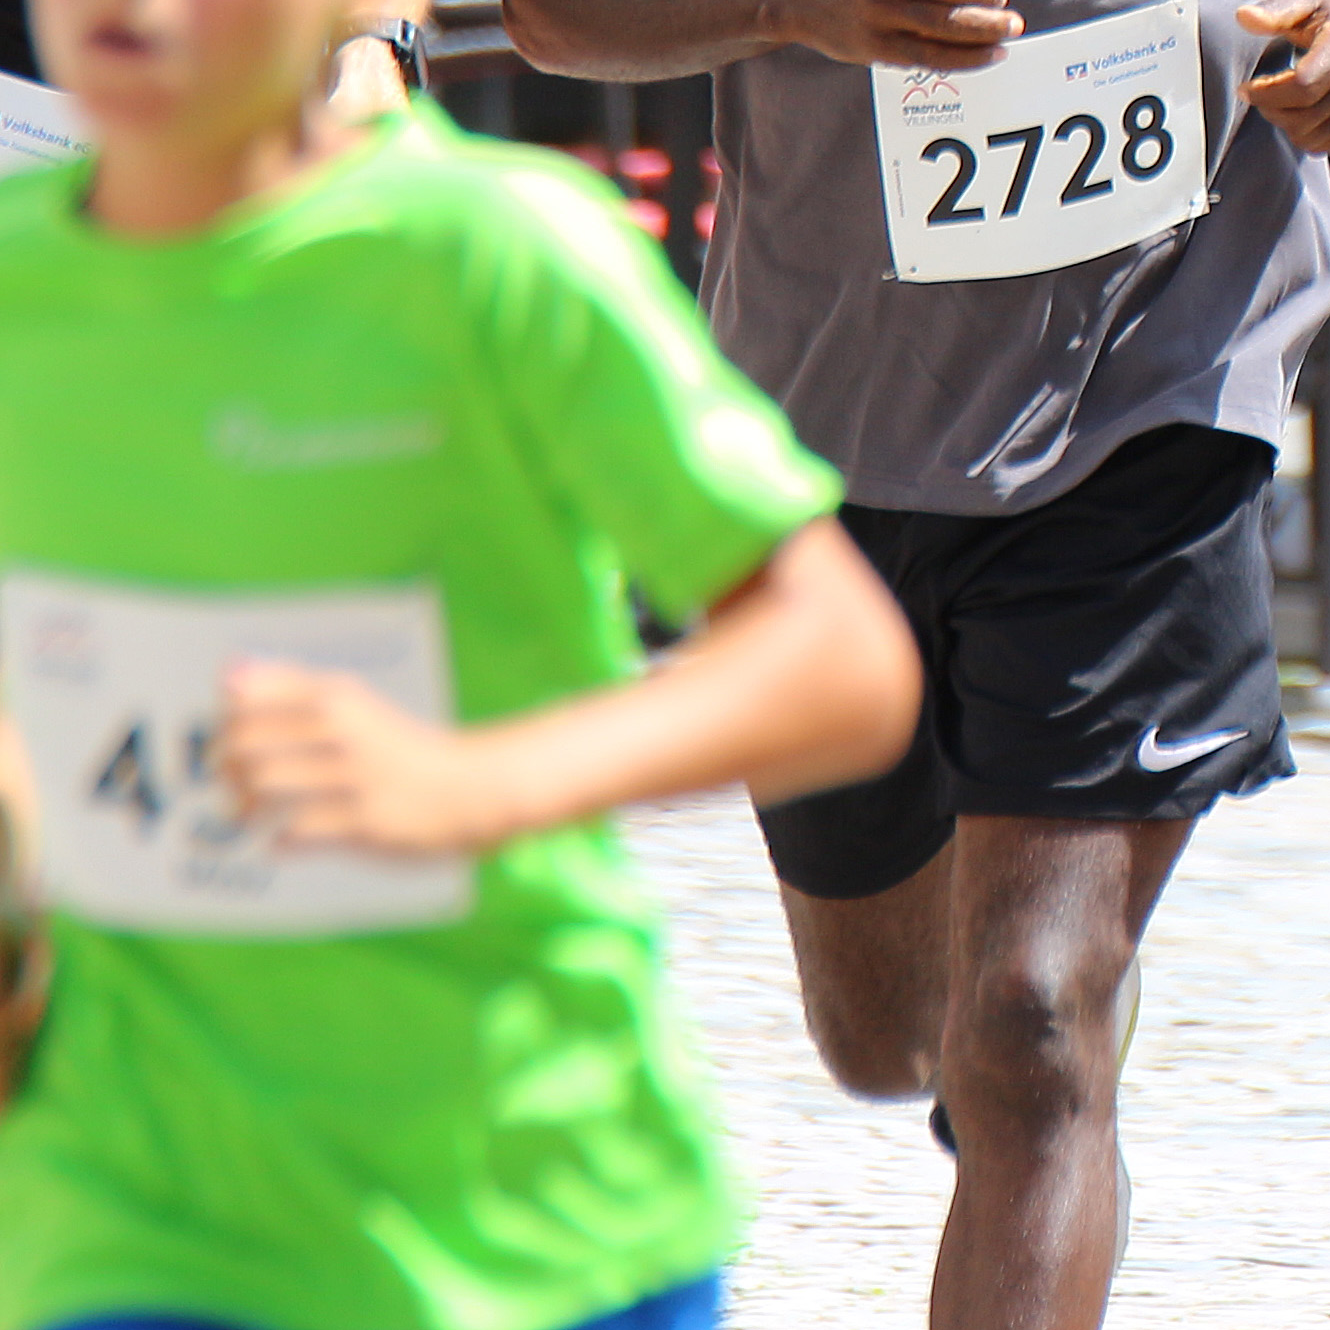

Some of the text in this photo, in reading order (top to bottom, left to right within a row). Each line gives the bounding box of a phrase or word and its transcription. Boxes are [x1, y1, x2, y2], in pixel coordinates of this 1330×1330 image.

[1092, 35, 1177, 70] Volksbank eG
[902, 102, 962, 117] STADTLAUF
[919, 94, 1175, 229] 2728
